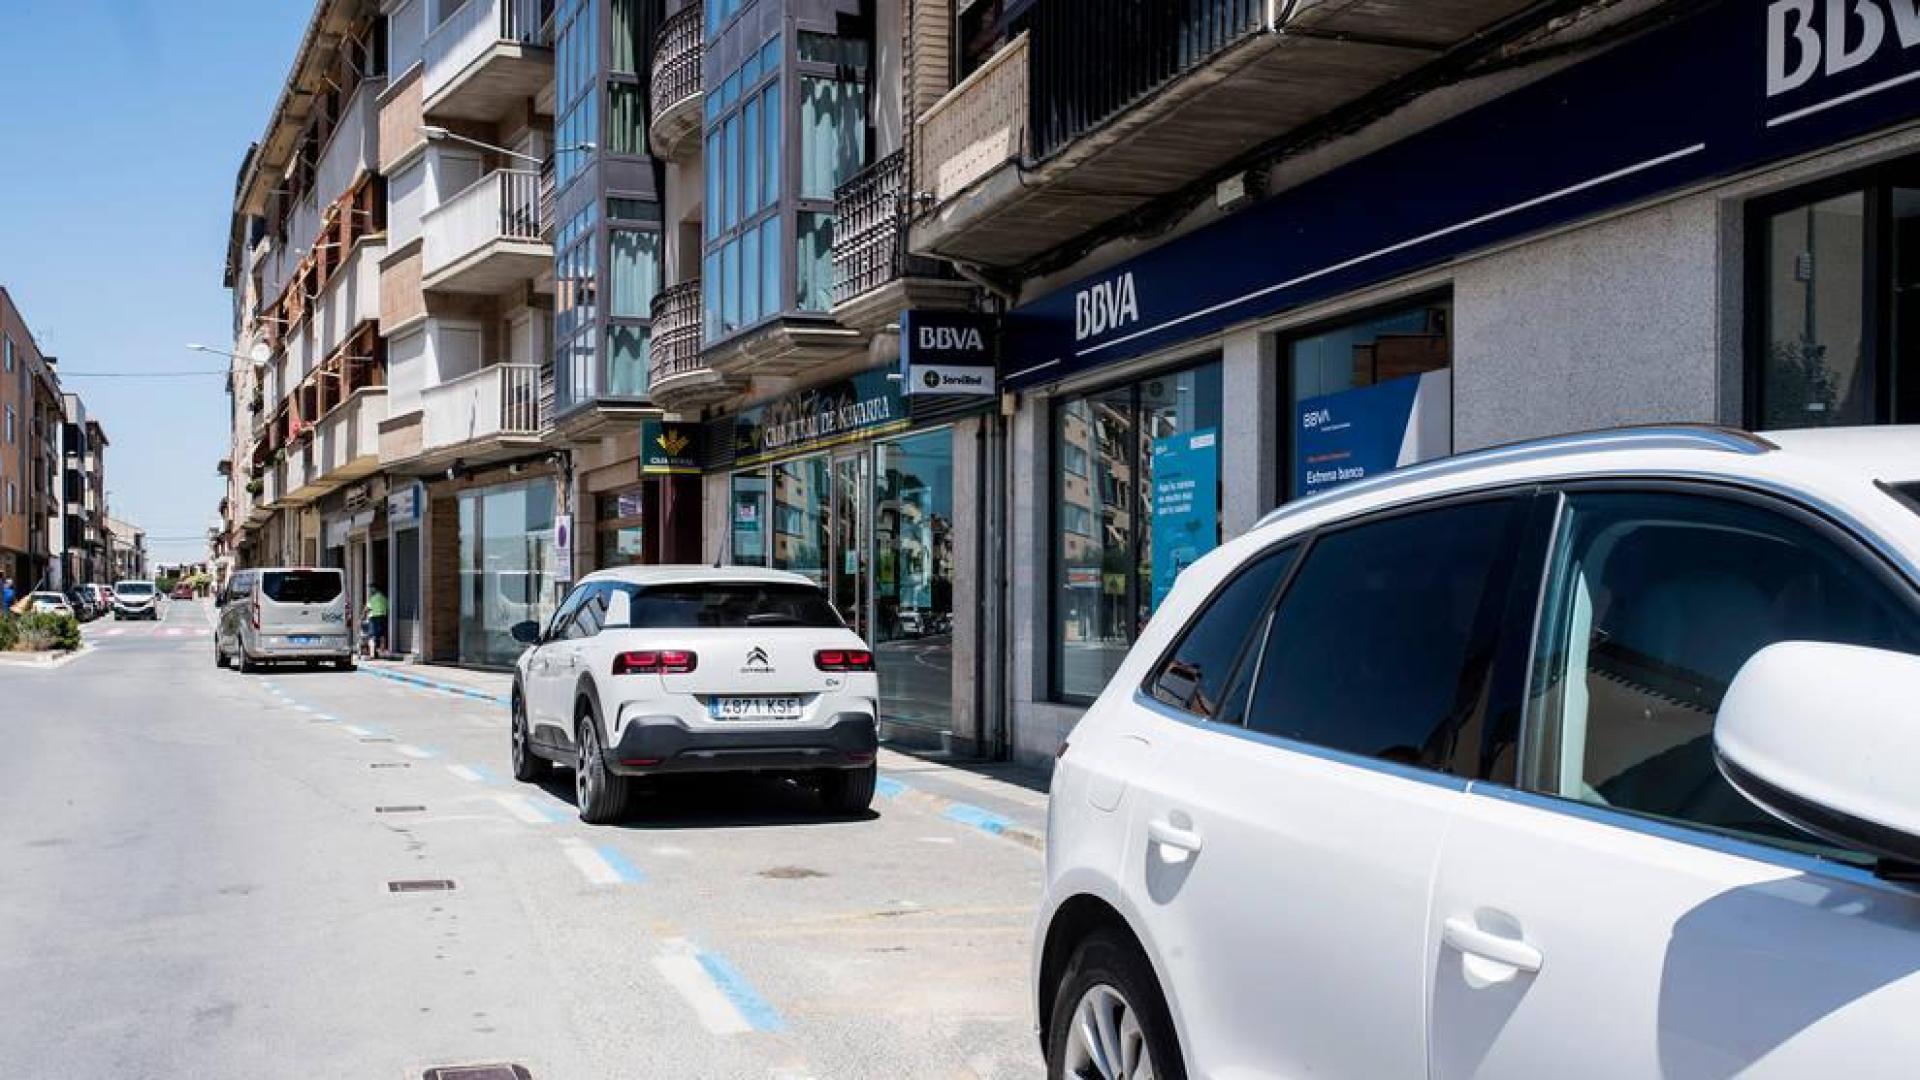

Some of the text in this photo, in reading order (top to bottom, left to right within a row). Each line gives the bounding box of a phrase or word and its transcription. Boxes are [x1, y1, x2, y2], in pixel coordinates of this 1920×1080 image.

[1076, 272, 1139, 341] BBVA
[919, 326, 984, 350] BBVA
[1303, 408, 1331, 428] BBVA
[1338, 466, 1364, 480] banco
[722, 699, 795, 715] 4871 KSF
